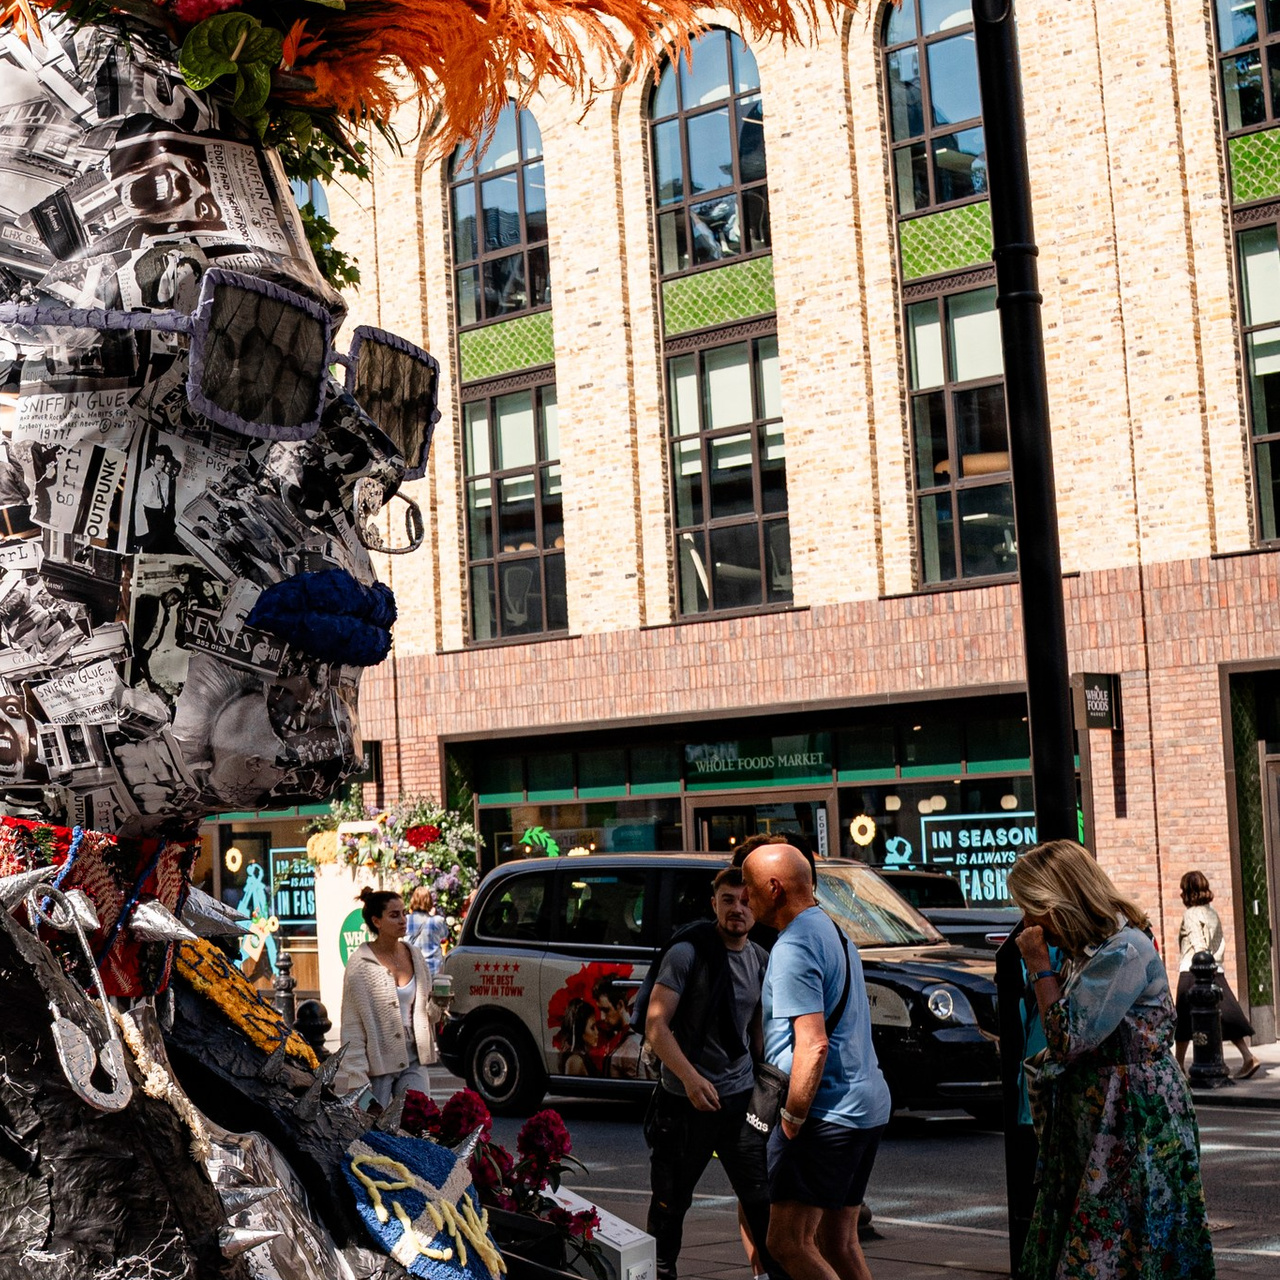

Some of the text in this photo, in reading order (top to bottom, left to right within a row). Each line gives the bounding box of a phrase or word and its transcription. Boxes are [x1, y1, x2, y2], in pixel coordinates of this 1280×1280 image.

[21, 394, 84, 413] SNIFFIN'
[87, 458, 118, 538] OUTPUNK
[1085, 690, 1108, 700] WHOLE
[1087, 701, 1108, 711] FOODS
[696, 752, 824, 773] WHOLE FOODS MARKET
[932, 827, 1037, 848] IN SEASON
[956, 851, 1016, 865] IS ALWAYS
[290, 878, 298, 887] IS
[277, 891, 289, 915] IN
[496, 975, 514, 984] BEST
[470, 986, 490, 996] SHOW
[491, 986, 499, 996] IN
